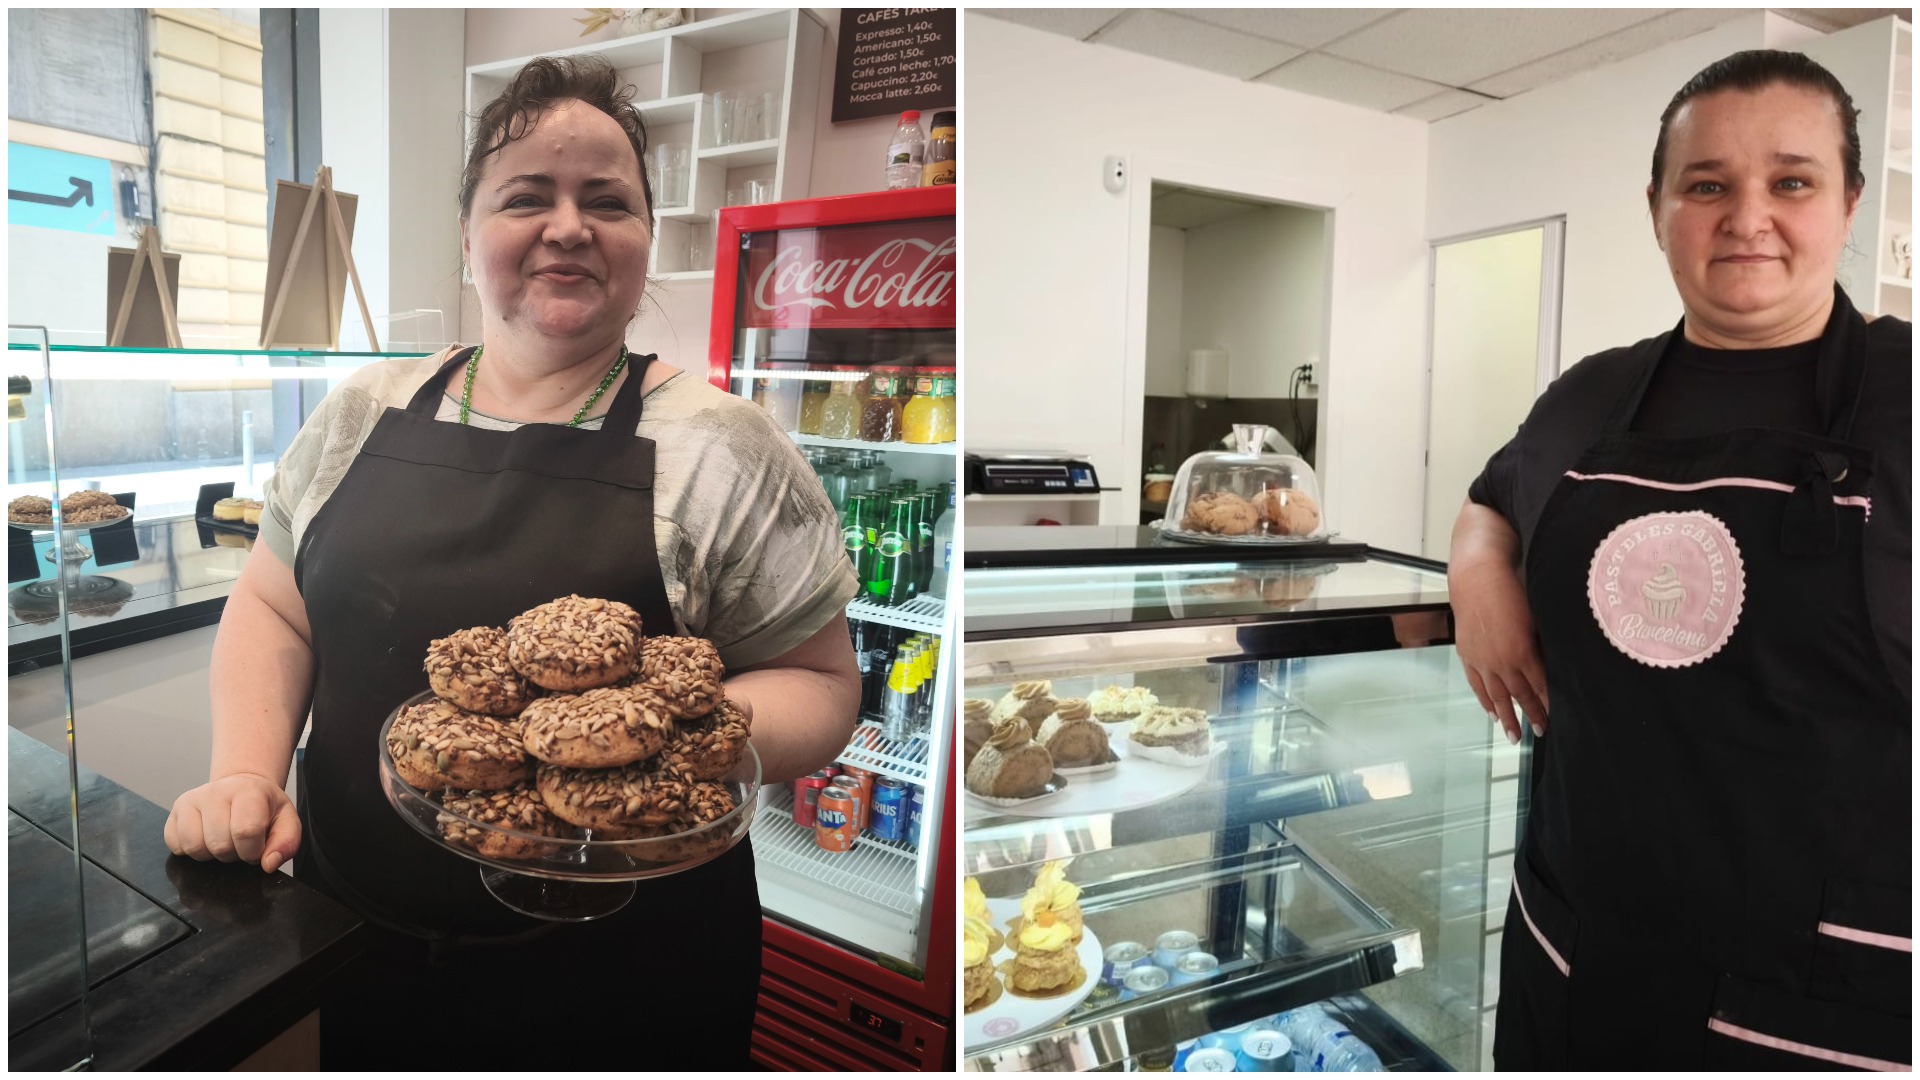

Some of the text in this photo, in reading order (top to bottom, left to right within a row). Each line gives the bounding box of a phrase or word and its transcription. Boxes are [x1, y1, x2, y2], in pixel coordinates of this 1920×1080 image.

[857, 8, 900, 25] CAFÉS
[855, 21, 933, 42] Expresso: 1,40€
[854, 32, 942, 54] Americano: 1,50€
[853, 48, 924, 66] Cortado: 1,50€
[852, 66, 875, 79] Café
[877, 65, 896, 75] con
[900, 60, 931, 72] leche:
[850, 71, 938, 91] Capuccino: 2,20€
[849, 83, 942, 103] Mocca latte: 2,60€
[1604, 523, 1727, 623] PASTELES GABRIELA
[1617, 613, 1708, 648] Barcelona
[817, 808, 847, 825] ANTA
